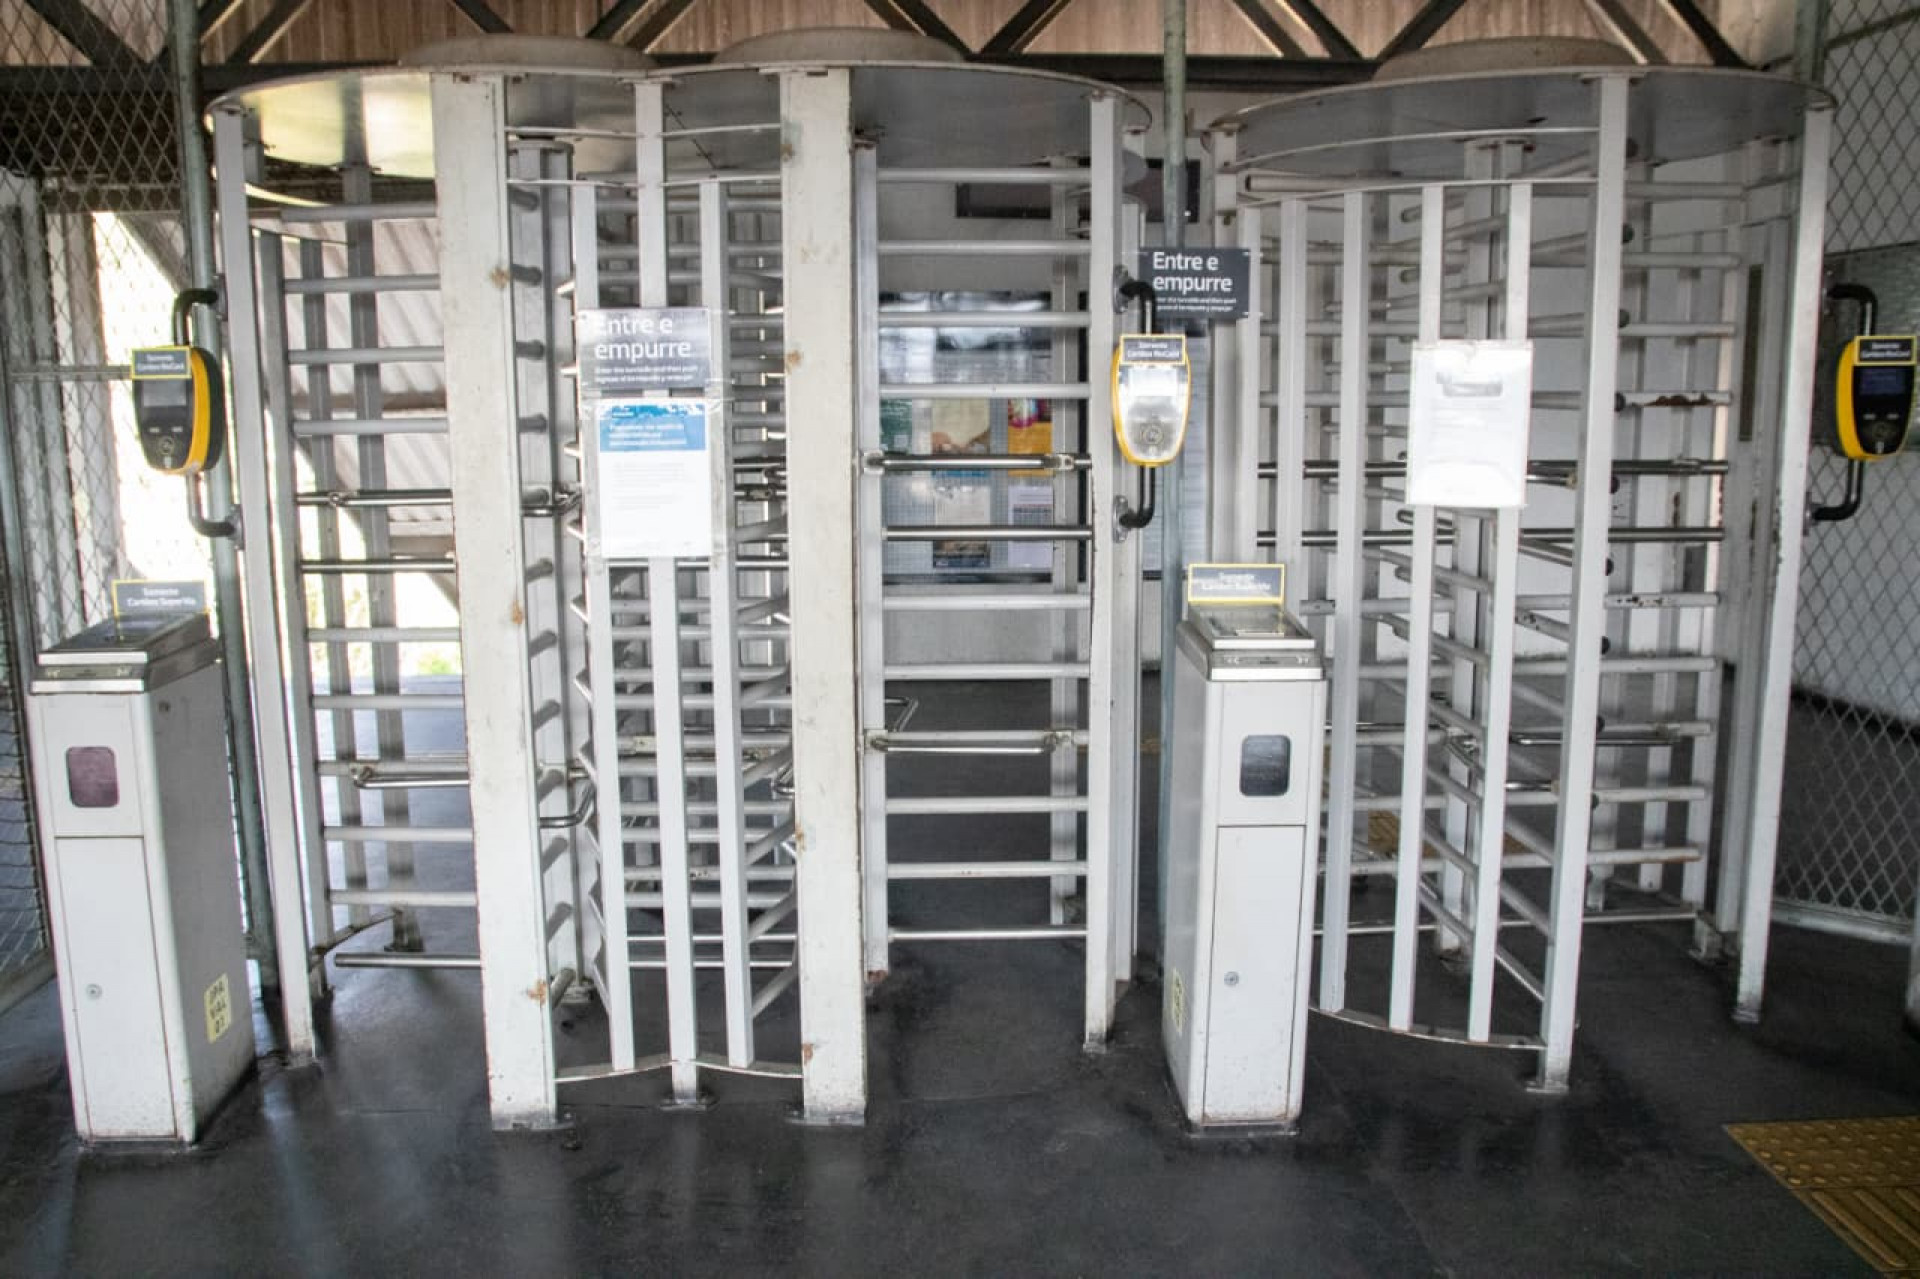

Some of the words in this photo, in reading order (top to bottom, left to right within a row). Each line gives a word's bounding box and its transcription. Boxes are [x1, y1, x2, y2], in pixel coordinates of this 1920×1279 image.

[1153, 252, 1203, 270] Entre
[1206, 256, 1219, 271] e
[1153, 276, 1233, 294] empurre
[659, 317, 673, 334] e
[595, 341, 692, 364] empurre
